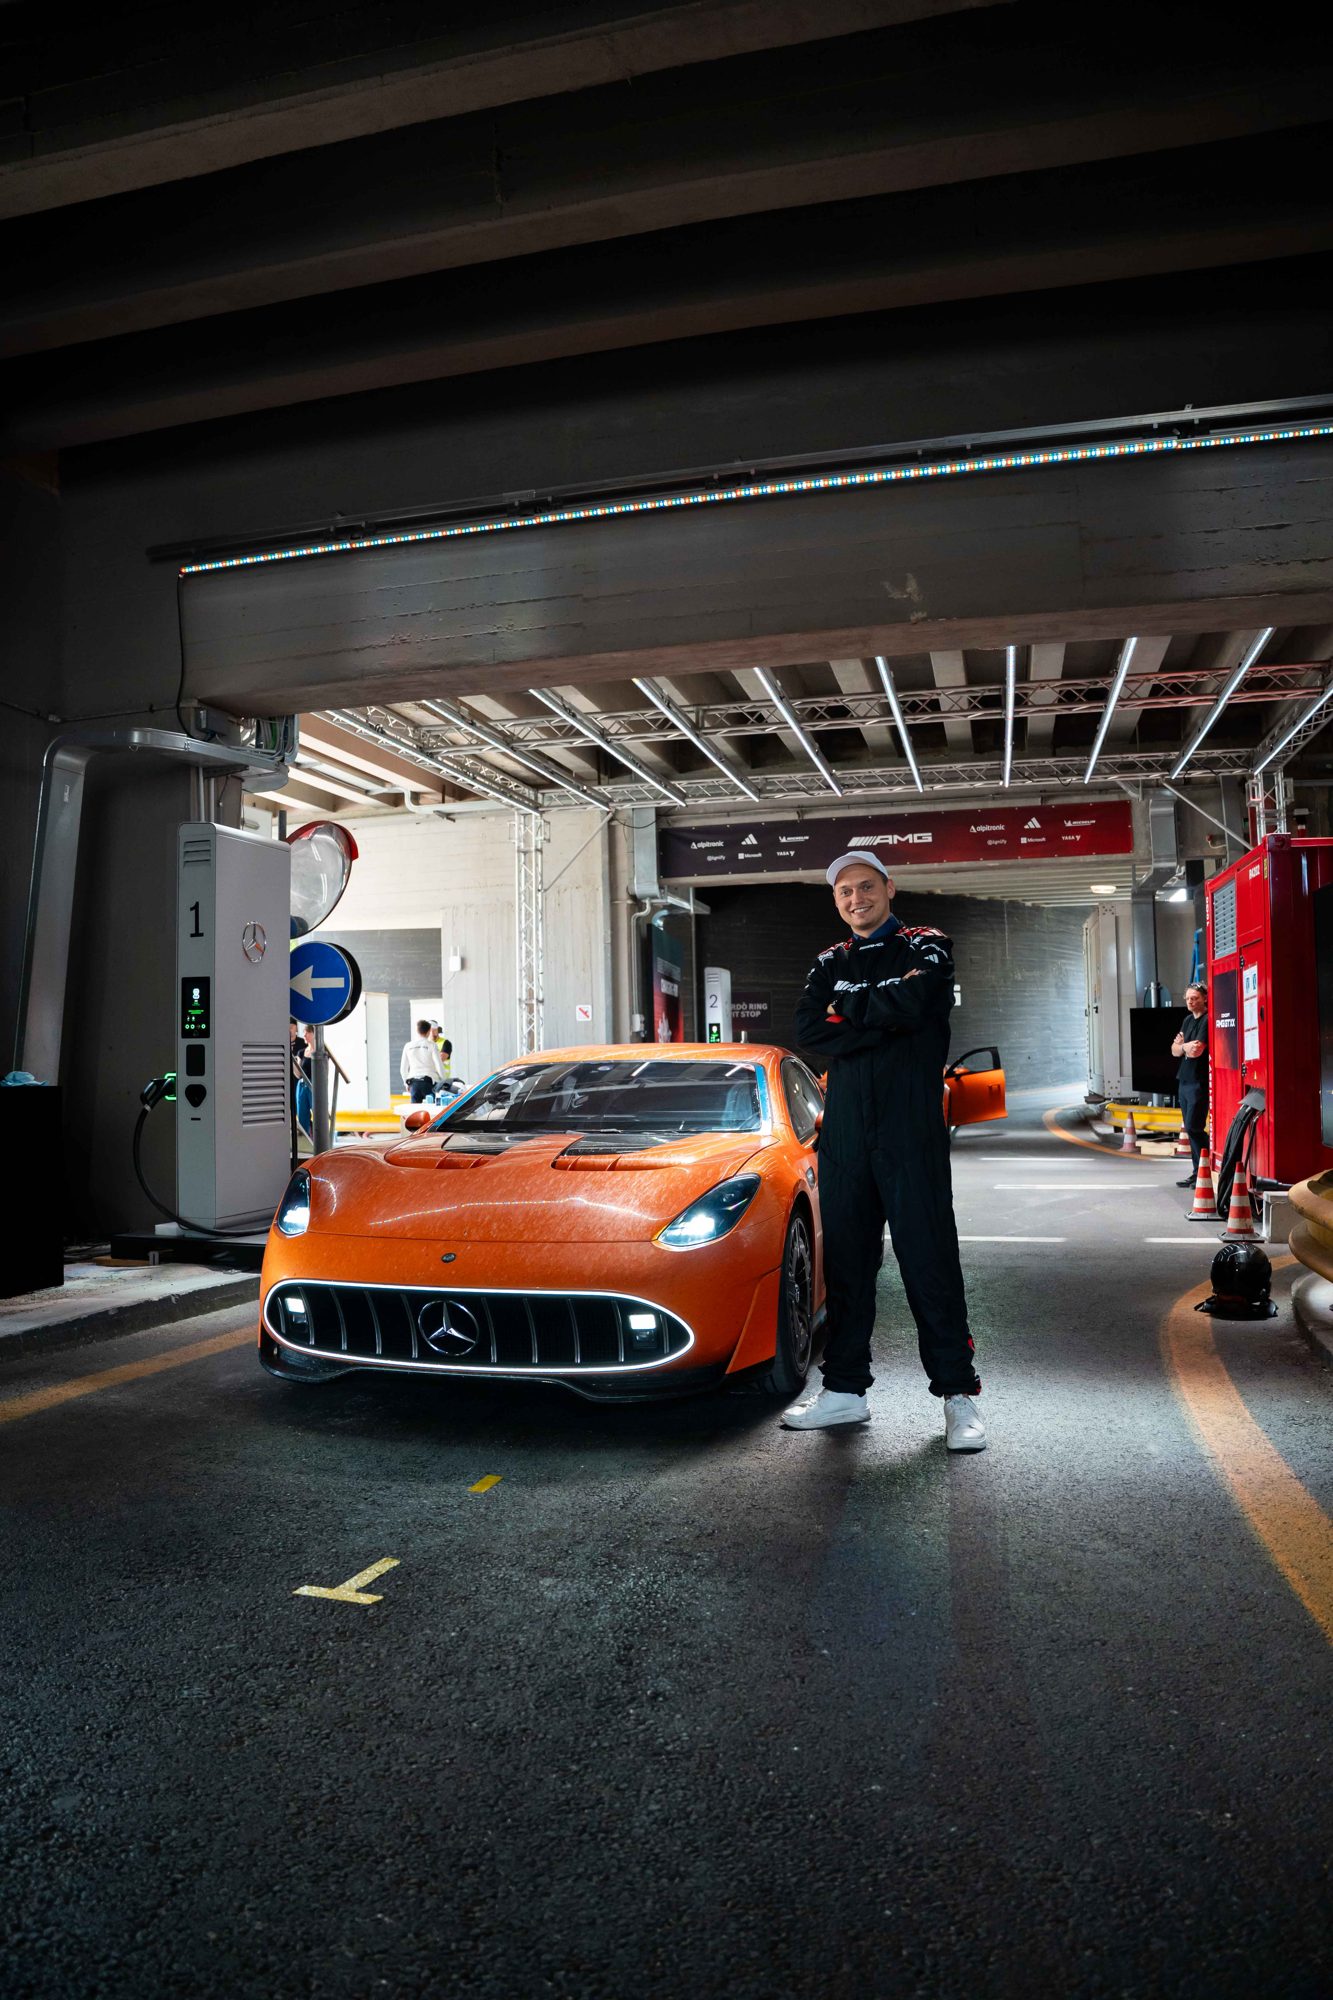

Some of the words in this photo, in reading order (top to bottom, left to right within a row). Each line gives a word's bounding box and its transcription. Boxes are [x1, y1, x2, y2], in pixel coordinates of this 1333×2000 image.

[976, 824, 1005, 832] alpitronic
[872, 832, 933, 846] AMG
[697, 840, 724, 849] alpitronic
[190, 901, 204, 938] 1
[709, 994, 718, 1009] 2
[748, 1003, 768, 1011] RING
[740, 1010, 761, 1018] STOP
